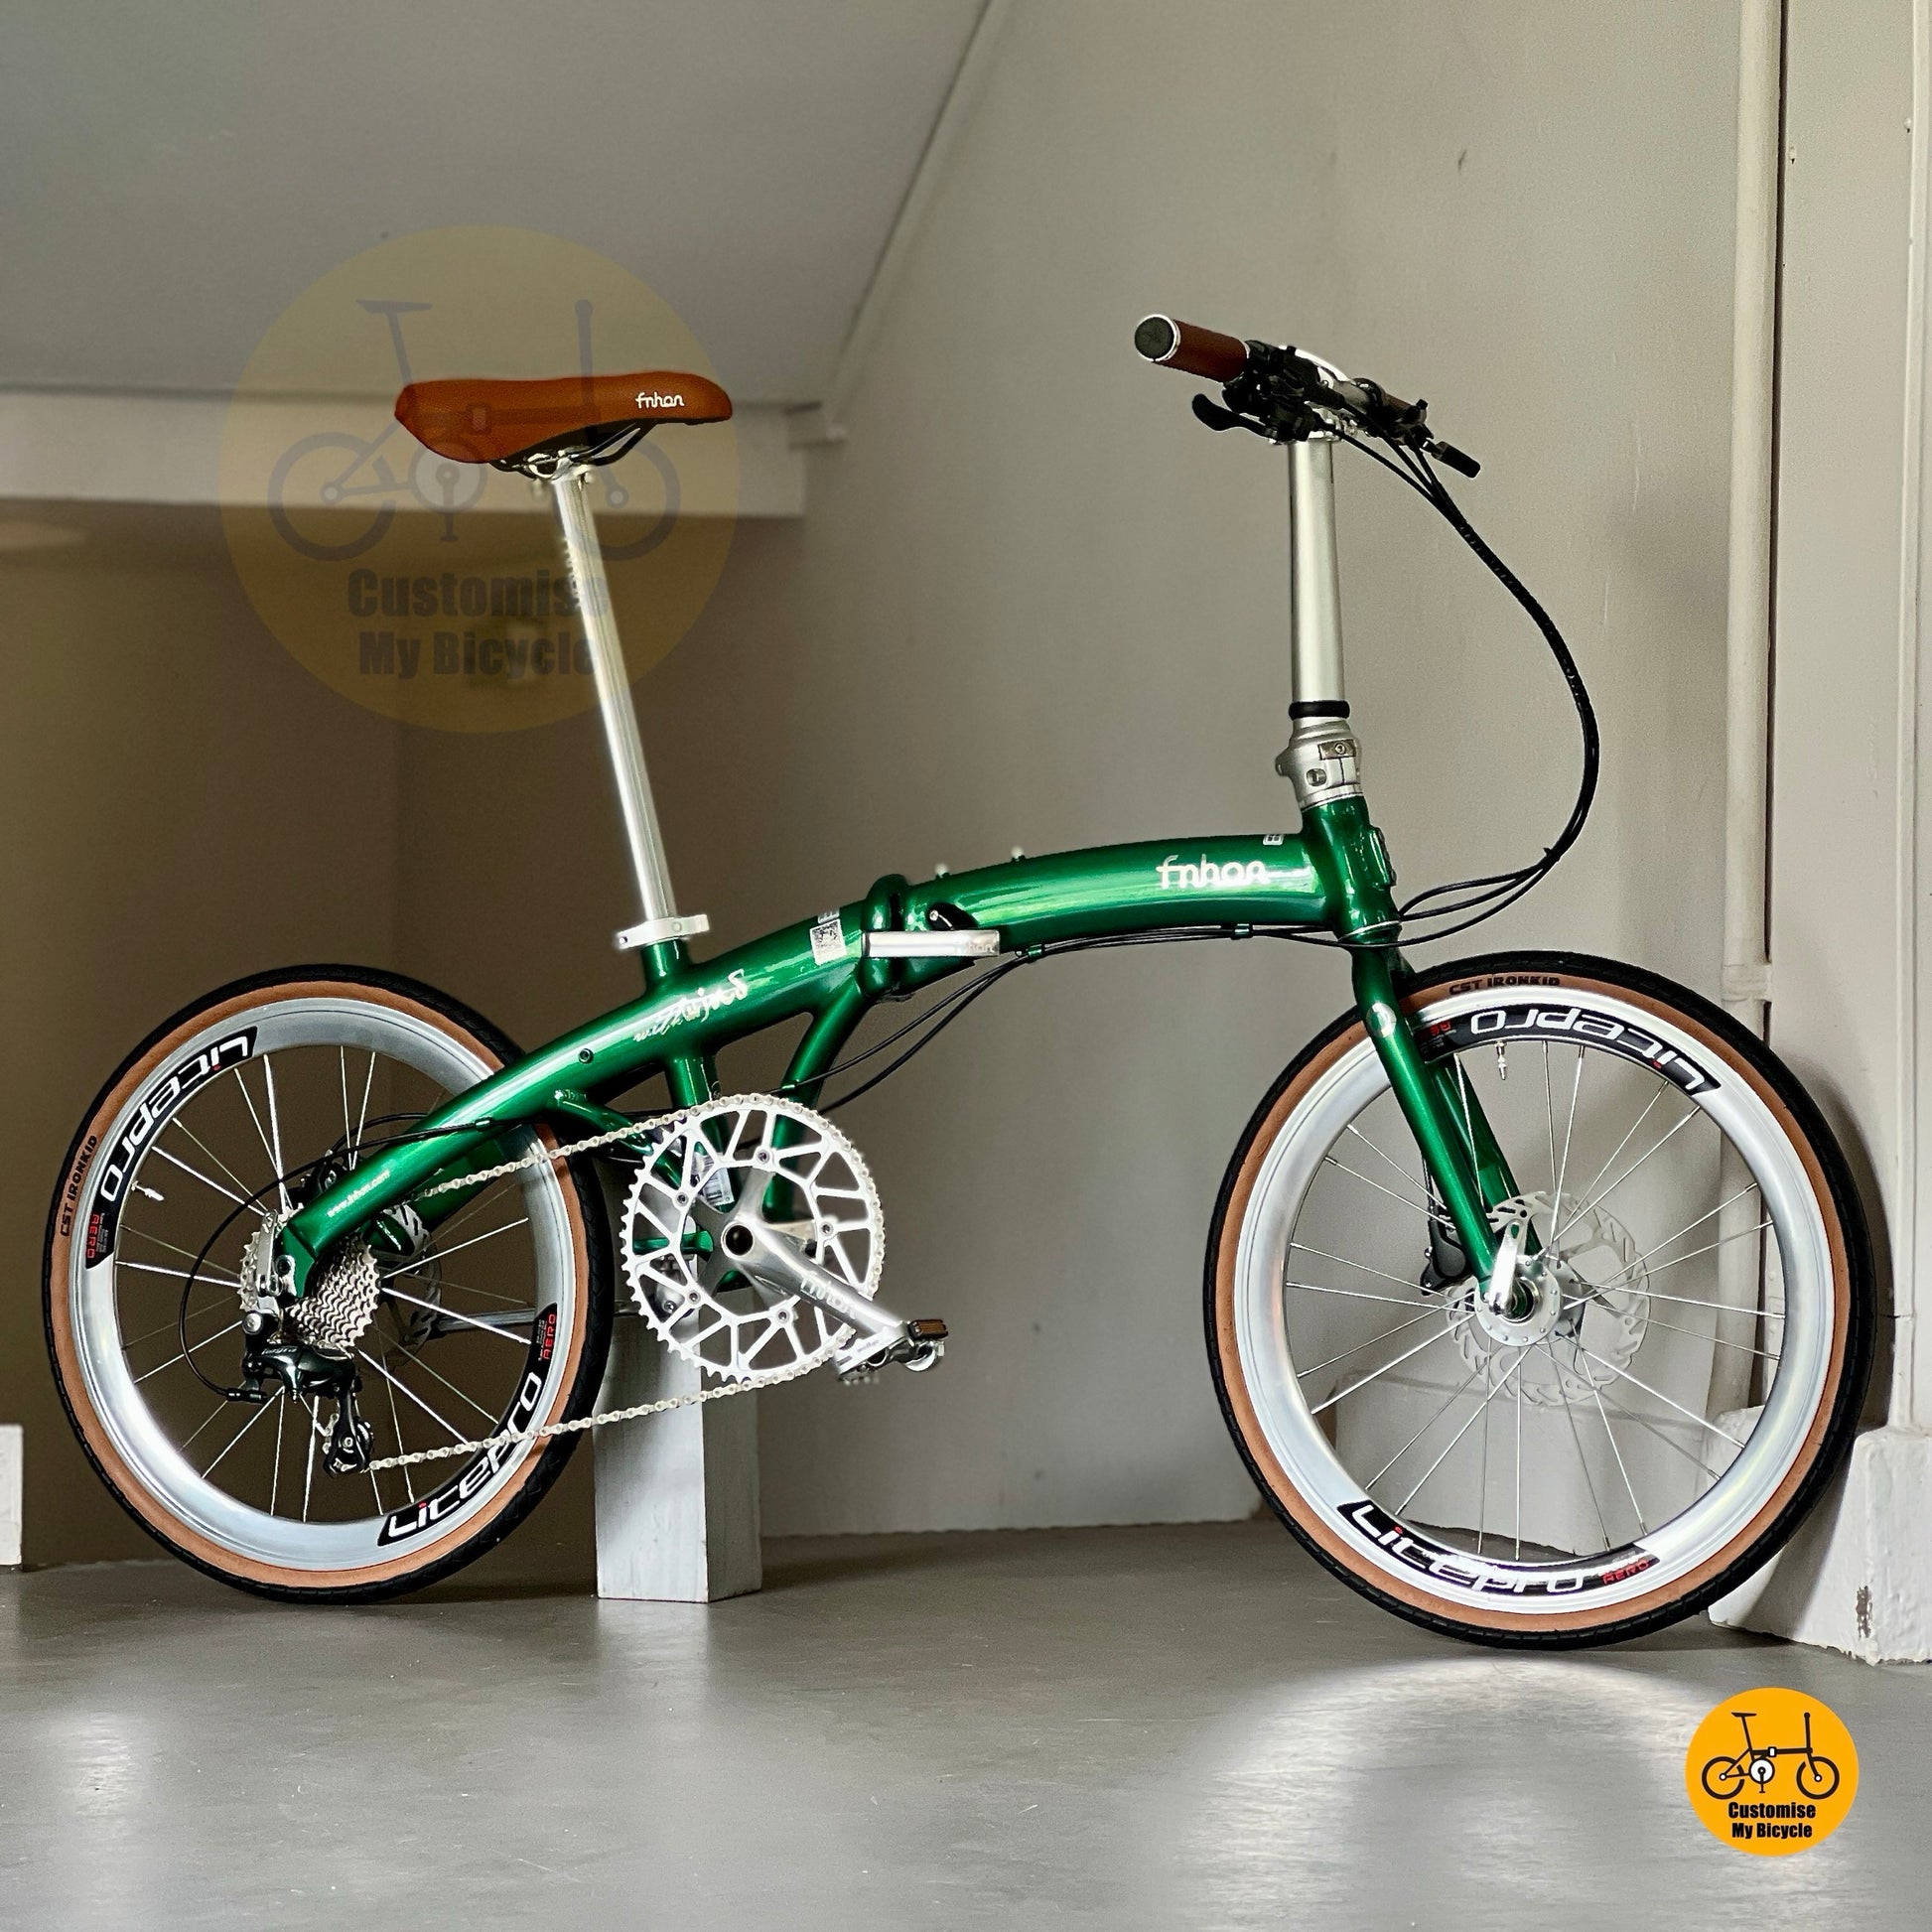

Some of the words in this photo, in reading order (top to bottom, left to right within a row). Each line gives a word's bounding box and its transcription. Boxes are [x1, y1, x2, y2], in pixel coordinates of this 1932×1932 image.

[635, 391, 685, 409] fnhon
[1155, 853, 1272, 890] fnhon
[1449, 978, 1480, 995] CST
[1487, 973, 1561, 988] IRONKID
[60, 1202, 73, 1237] CST
[67, 1134, 98, 1202] IRONKID
[85, 1212, 100, 1259] AERO
[541, 1312, 558, 1361] AERO
[1602, 1559, 1650, 1586] AERO
